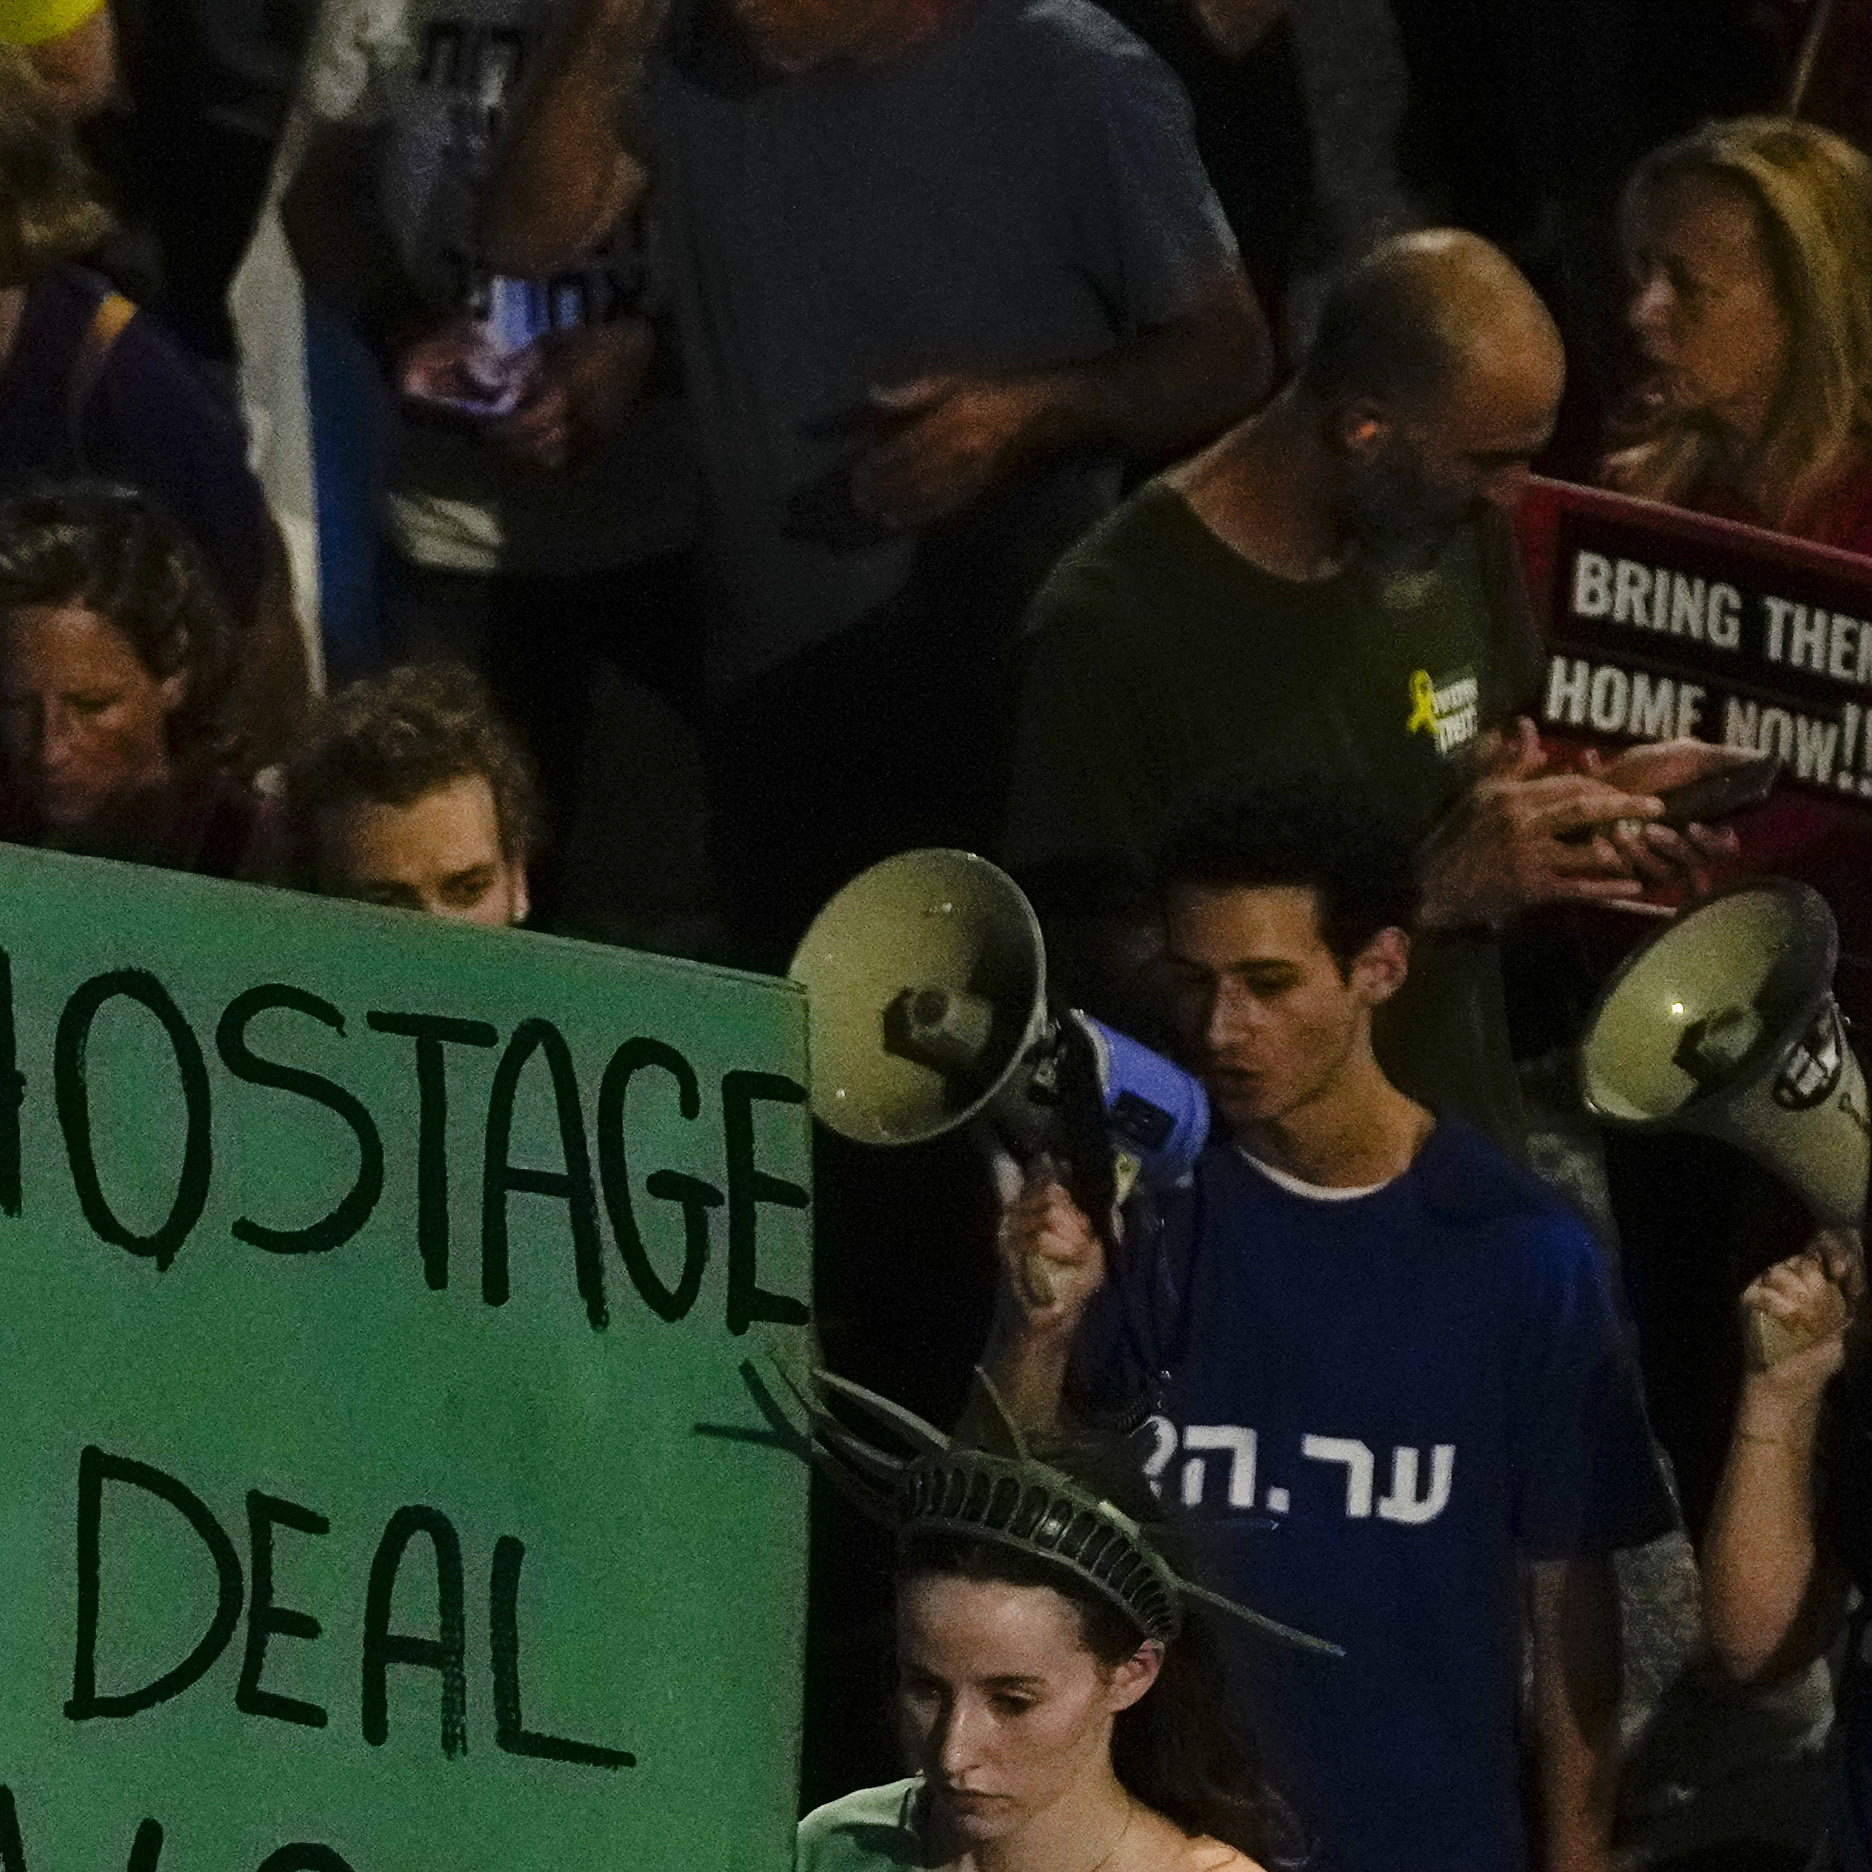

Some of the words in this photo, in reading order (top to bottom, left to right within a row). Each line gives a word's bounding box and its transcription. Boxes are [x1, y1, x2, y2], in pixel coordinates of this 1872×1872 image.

[1573, 548, 1742, 651] BRING
[1544, 654, 1707, 741] HOME
[68, 1444, 639, 1775] DEAL
